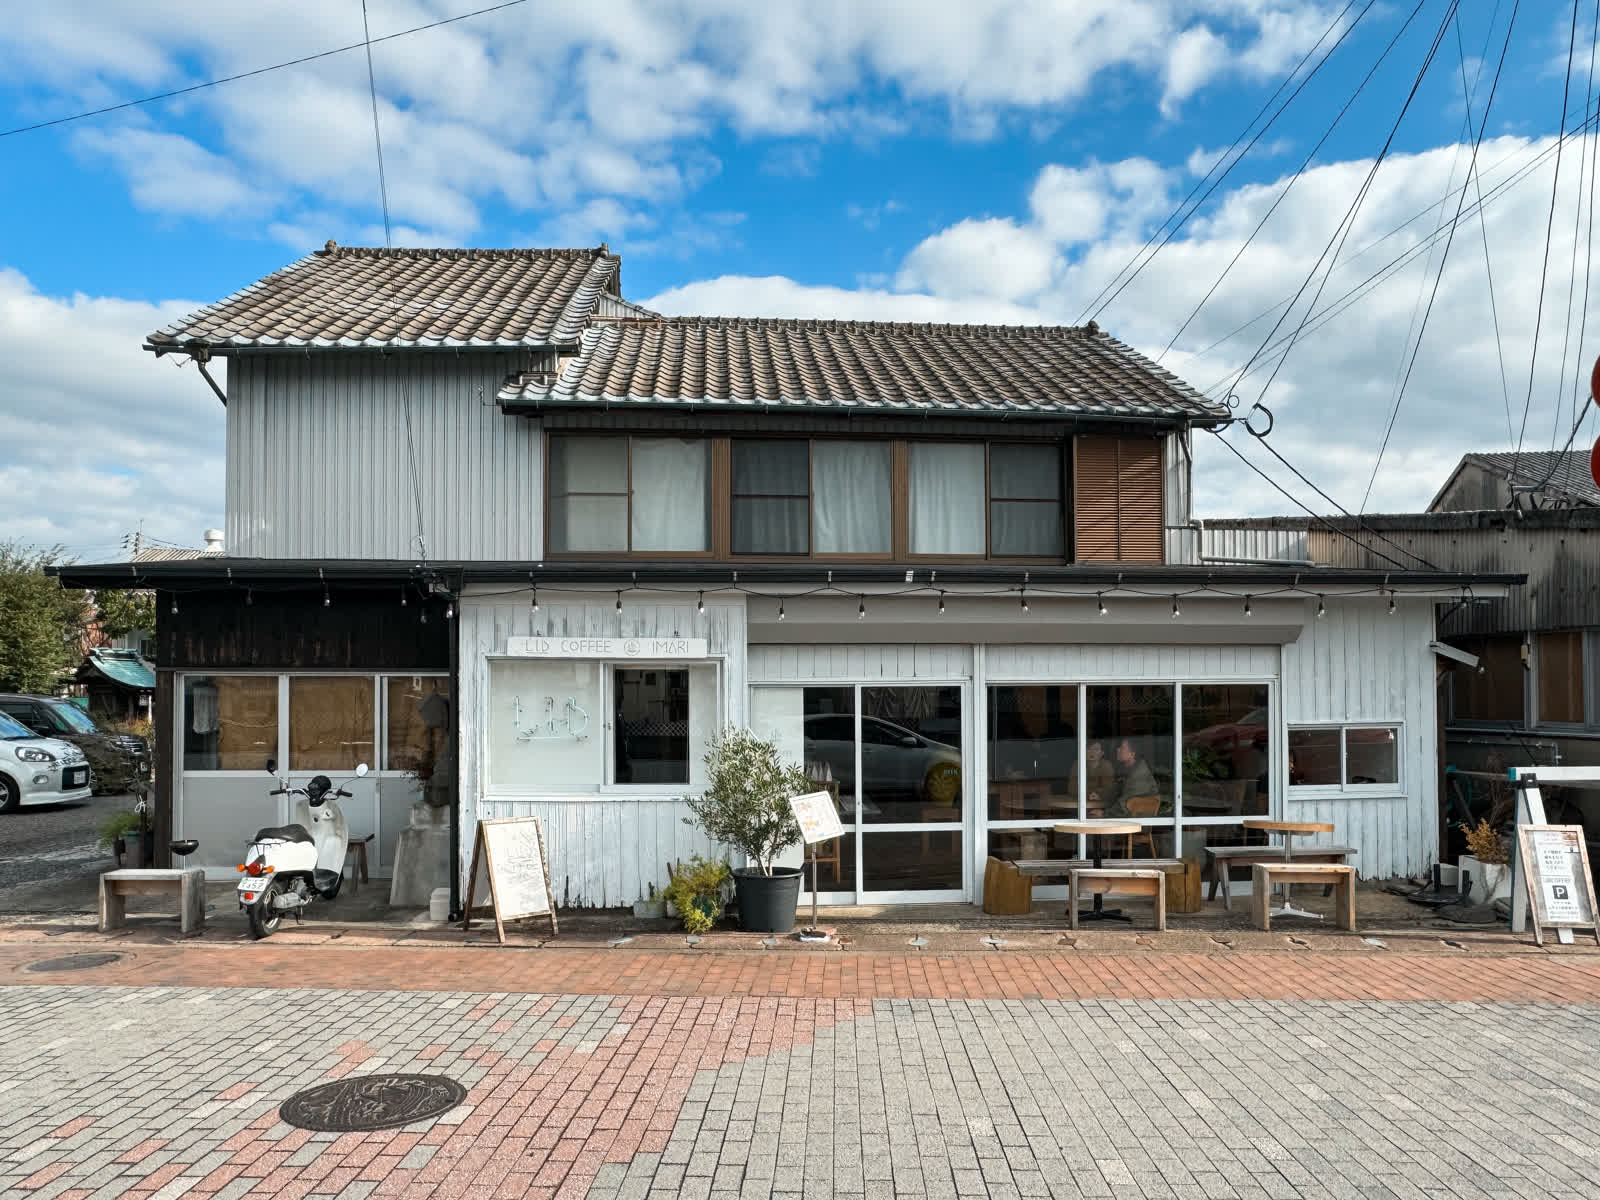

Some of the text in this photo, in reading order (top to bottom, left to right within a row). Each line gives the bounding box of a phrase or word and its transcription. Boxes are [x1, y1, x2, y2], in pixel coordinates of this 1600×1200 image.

[524, 640, 690, 653] LID COFFEE IMARI
